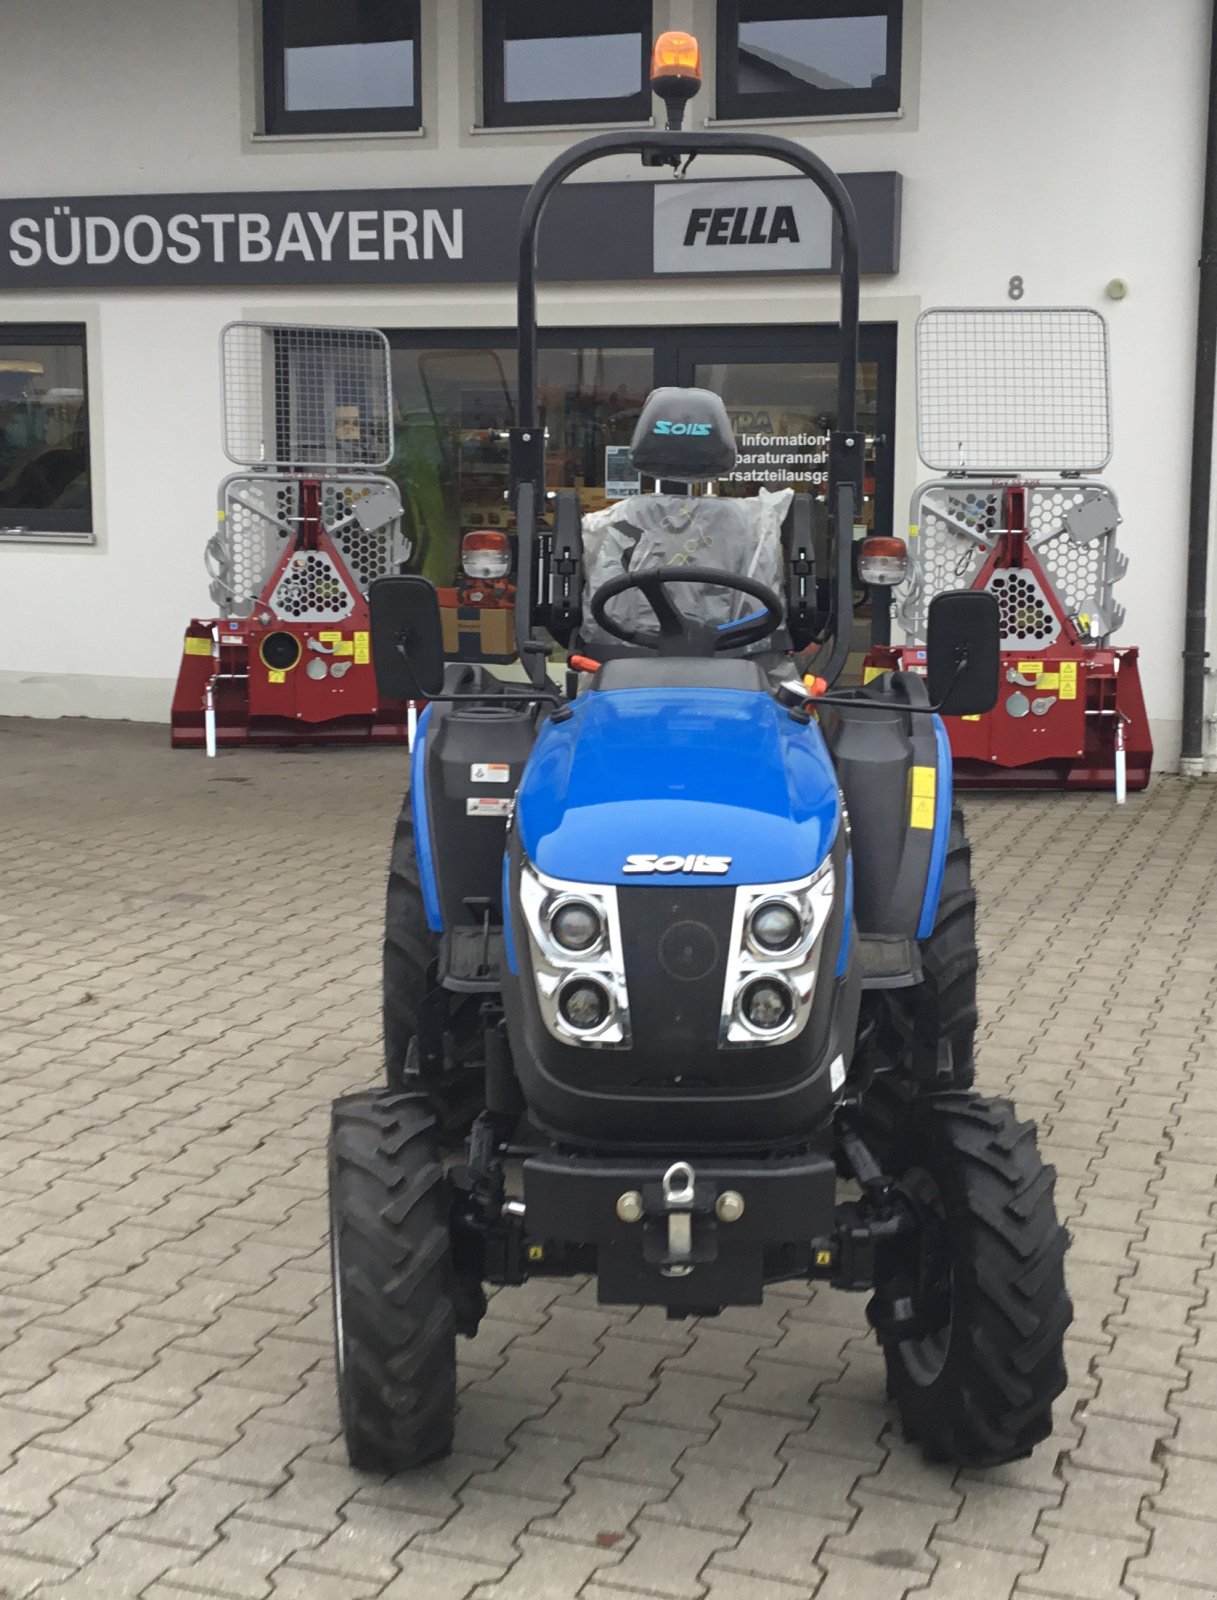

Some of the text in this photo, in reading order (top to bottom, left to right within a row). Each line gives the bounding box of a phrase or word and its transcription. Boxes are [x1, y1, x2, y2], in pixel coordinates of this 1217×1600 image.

[9, 206, 464, 266] SÜDOSTBAYERN
[683, 206, 800, 246] FELLA
[1008, 275, 1024, 300] 8
[742, 433, 825, 446] Information
